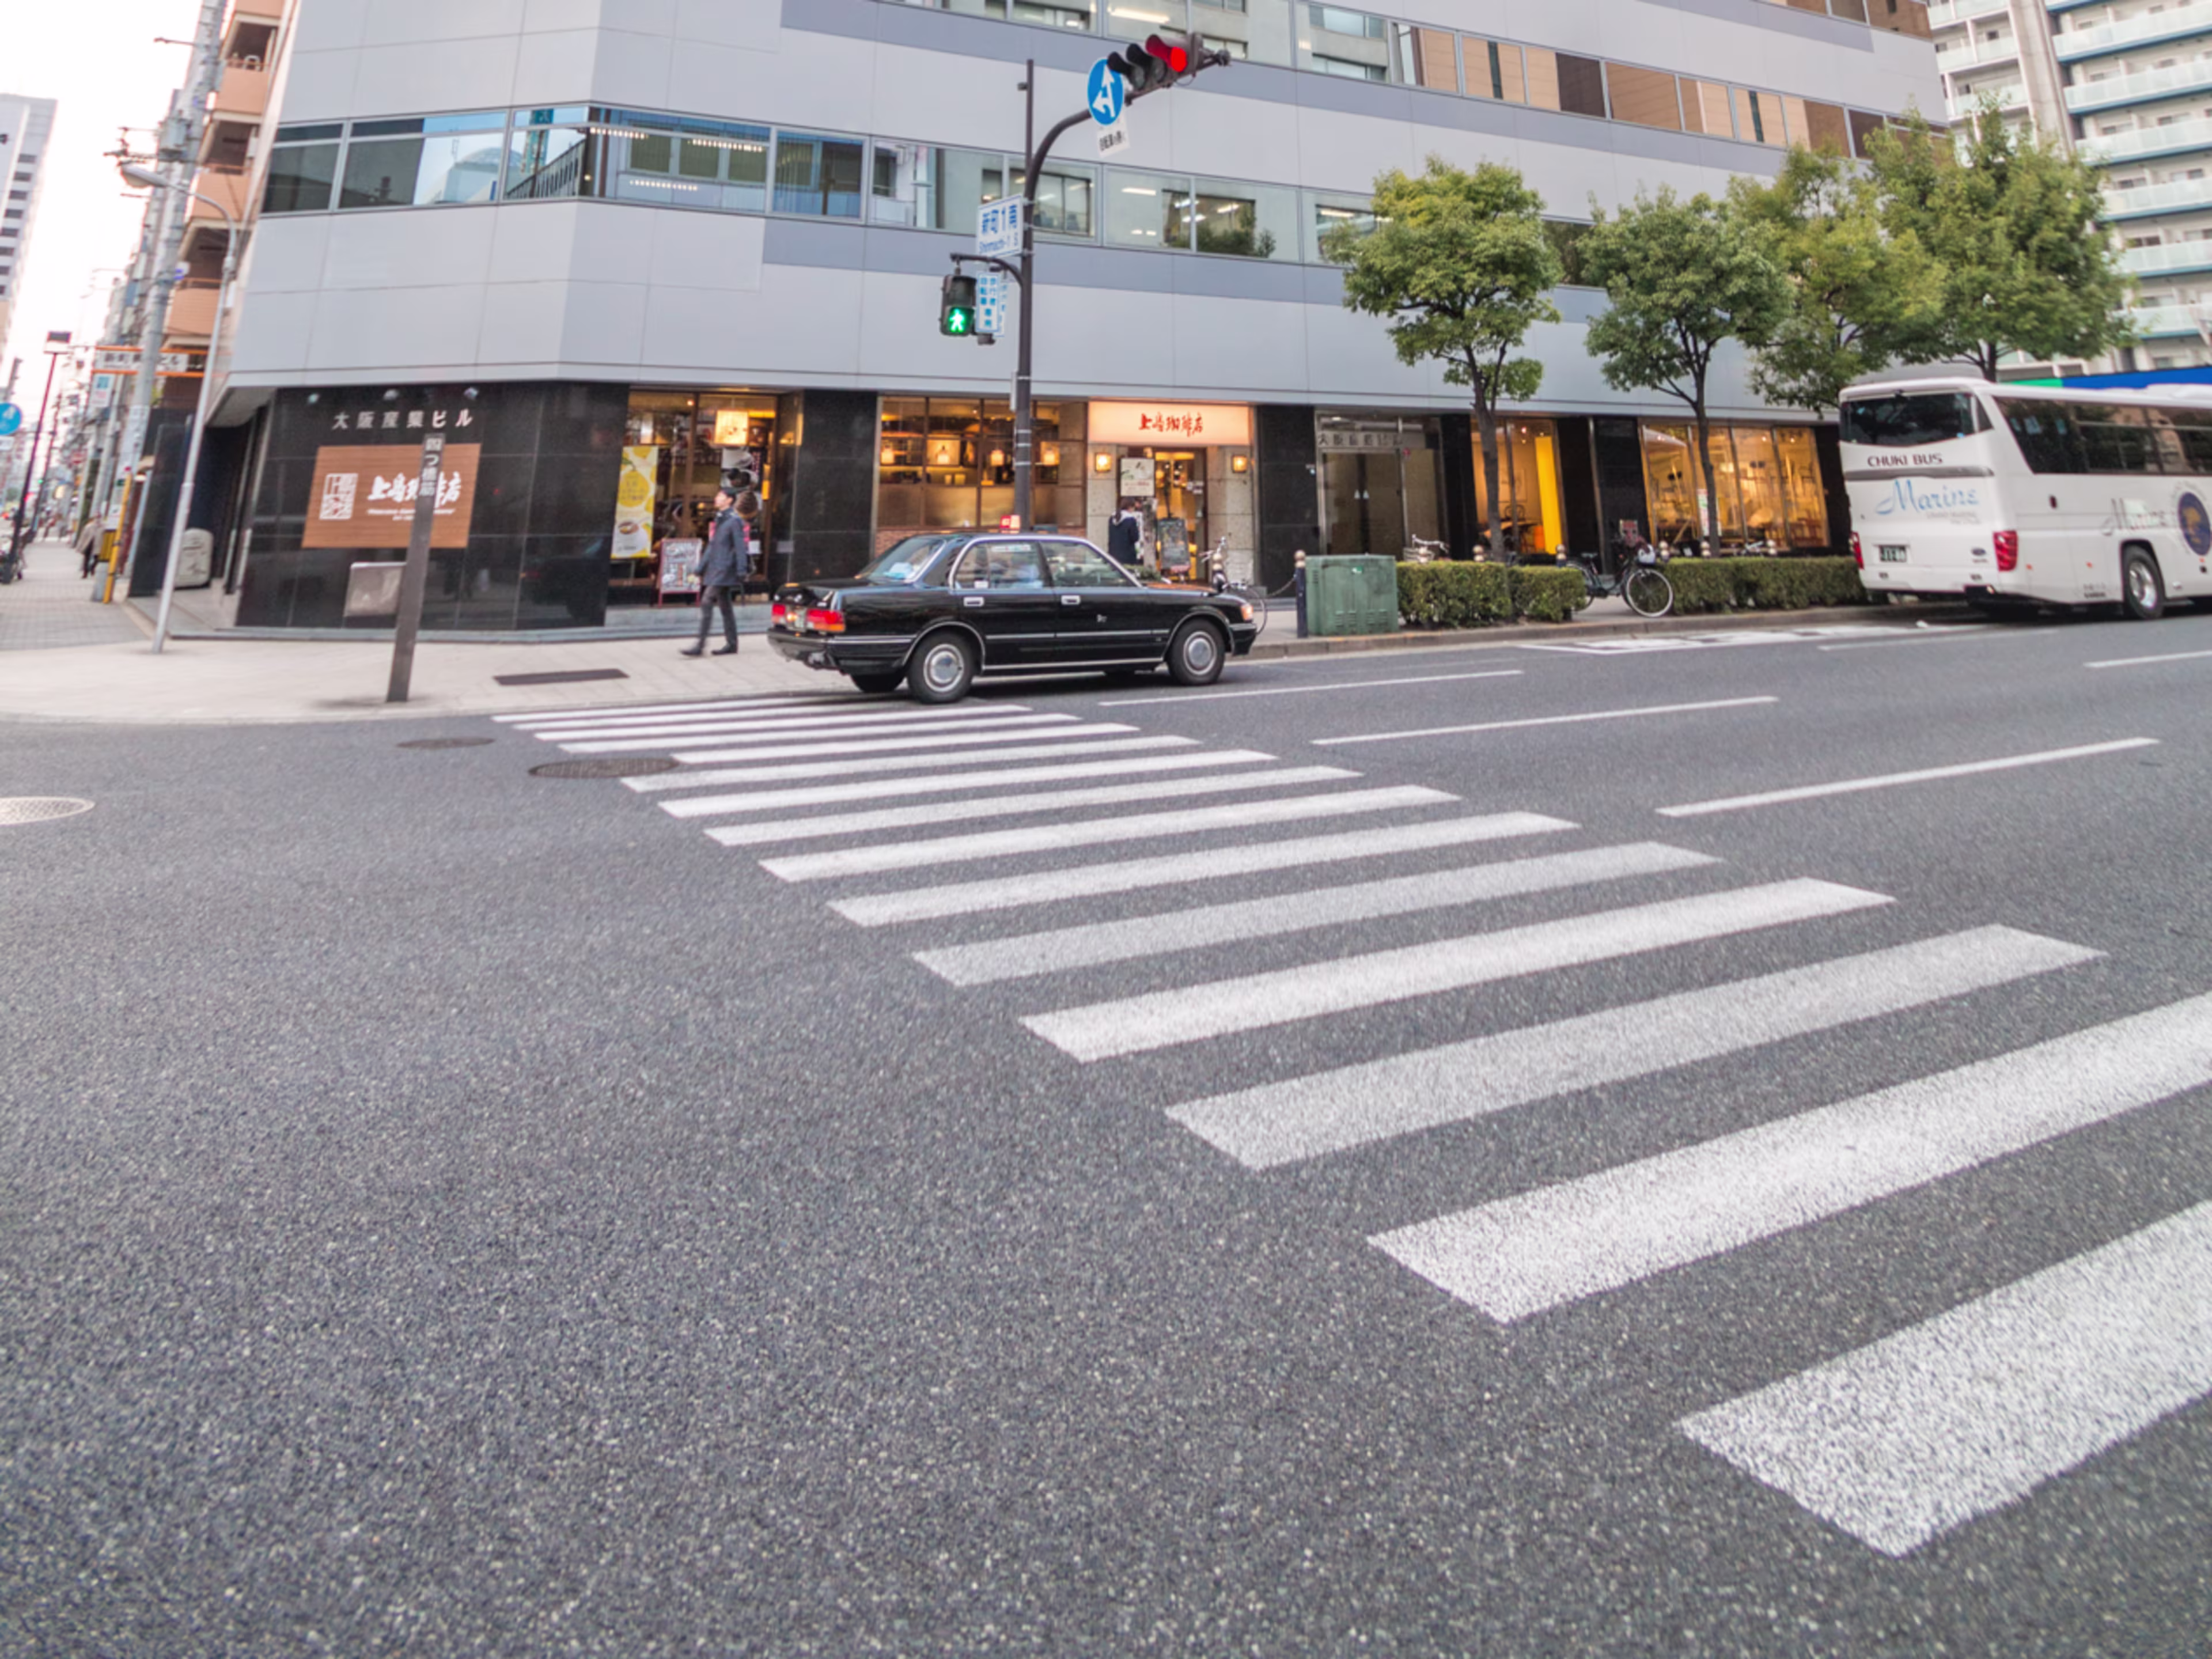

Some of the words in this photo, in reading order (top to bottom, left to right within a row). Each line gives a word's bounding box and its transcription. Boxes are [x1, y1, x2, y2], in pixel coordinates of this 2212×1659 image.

[1138, 411, 1203, 437] 上島珈琲店
[1867, 455, 1908, 467] CHUKI
[1912, 453, 1943, 465] BUS
